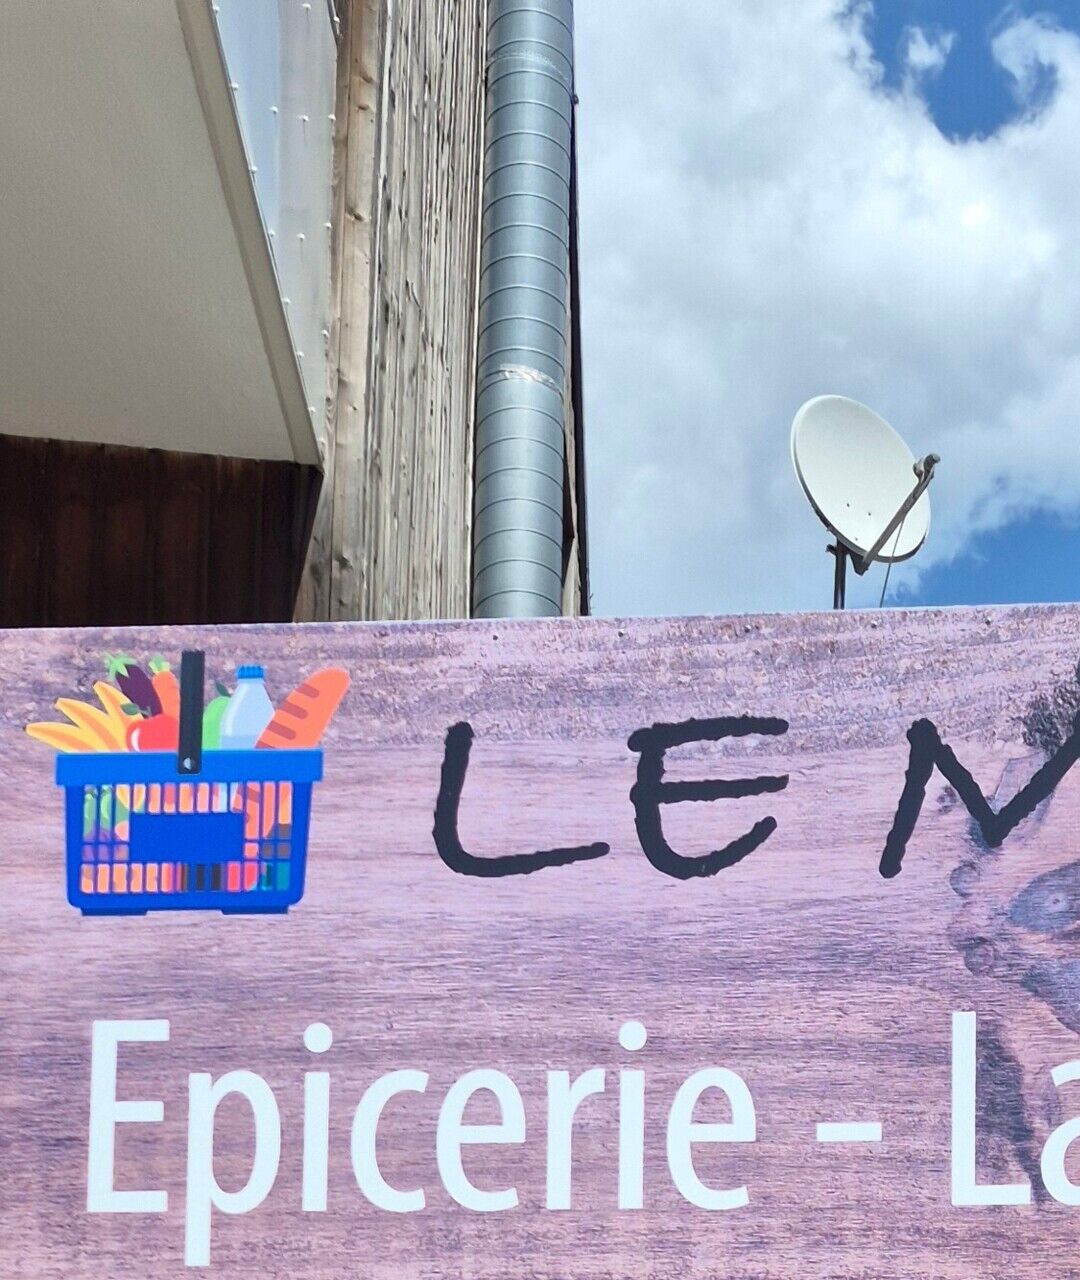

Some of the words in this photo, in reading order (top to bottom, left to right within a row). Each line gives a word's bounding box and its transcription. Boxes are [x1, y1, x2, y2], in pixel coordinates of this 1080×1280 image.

[430, 715, 790, 880] LE
[86, 1018, 758, 1267] Epicerie
[814, 1120, 884, 1143] -
